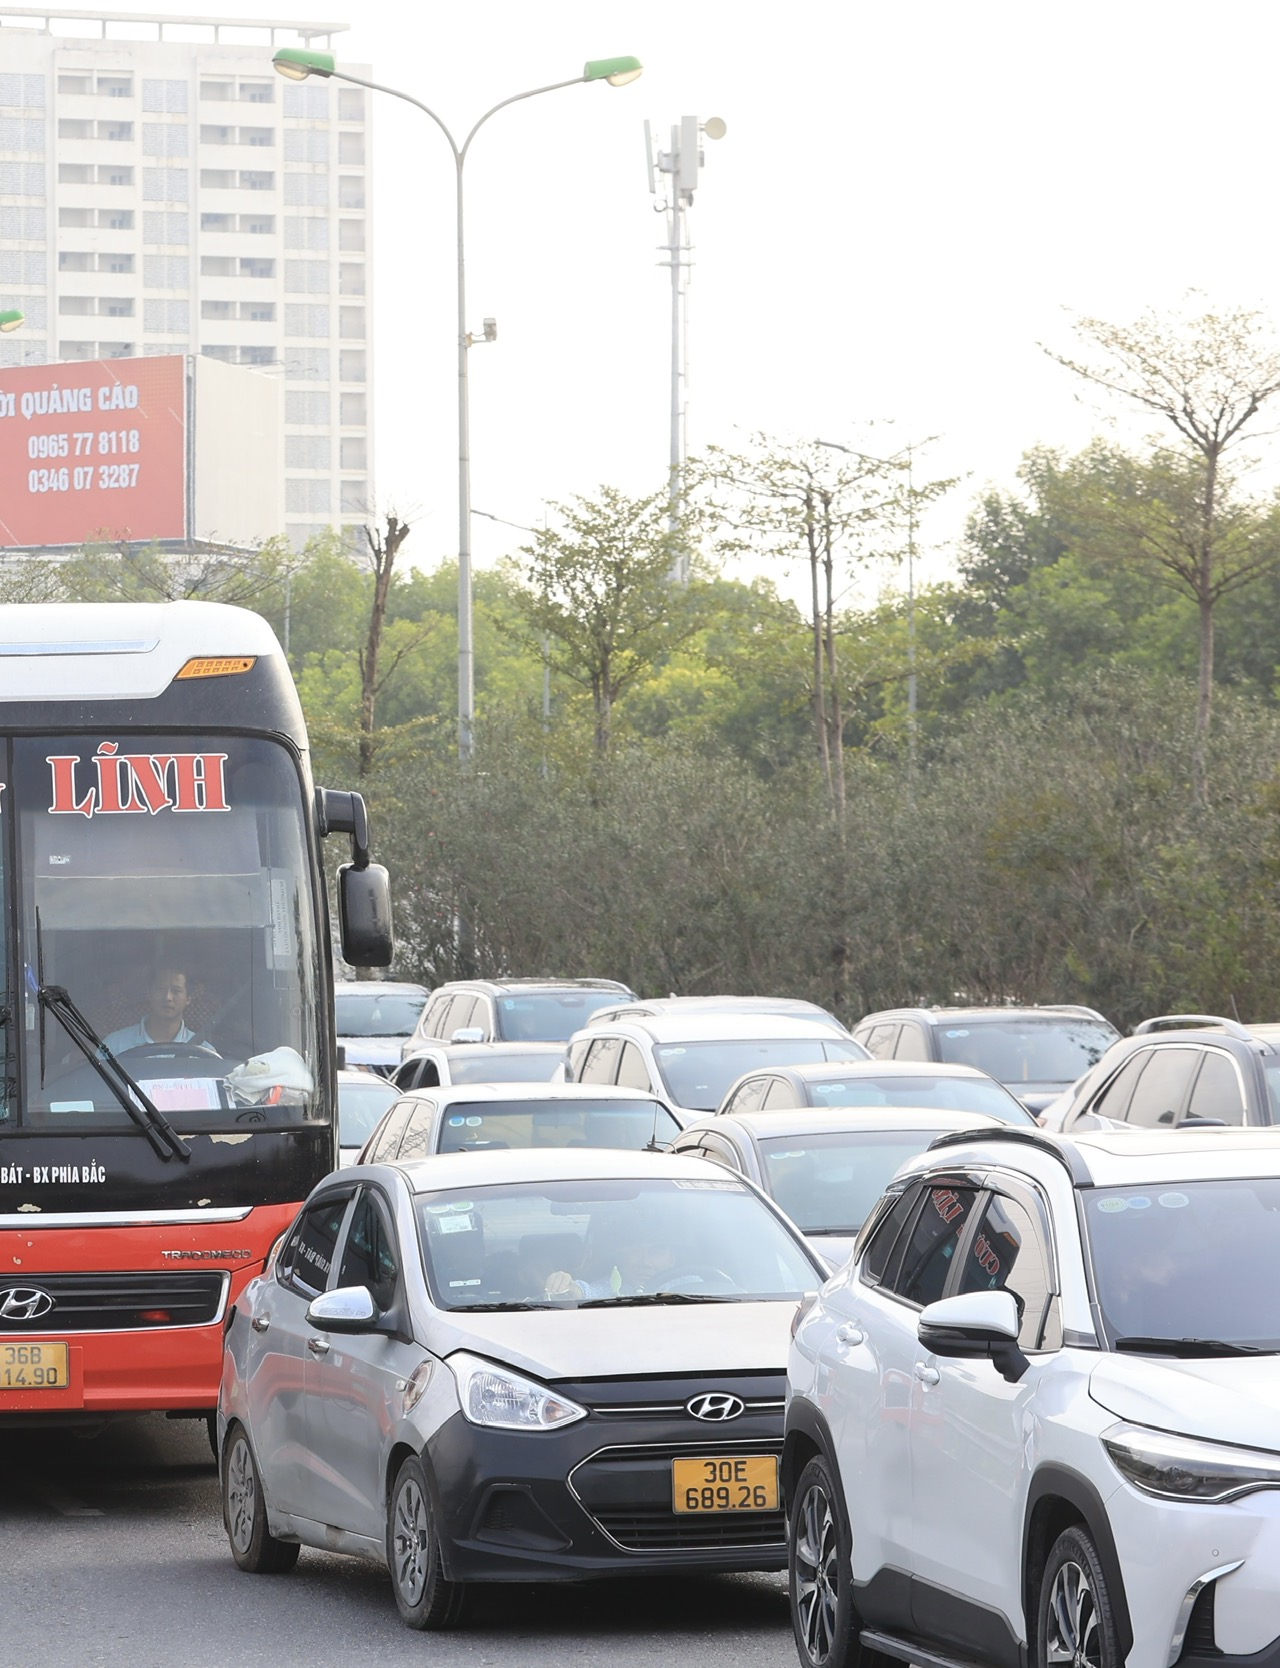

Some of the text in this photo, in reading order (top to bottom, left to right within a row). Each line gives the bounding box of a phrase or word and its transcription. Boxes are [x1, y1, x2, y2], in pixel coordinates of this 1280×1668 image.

[21, 384, 92, 420] QUẢNG
[98, 381, 139, 410] CÁO
[28, 430, 140, 459] 0965 77 8118
[28, 464, 140, 493] 0346 07 3287
[46, 741, 232, 819] LĨNH
[1, 1162, 23, 1184] BÁT
[33, 1166, 50, 1184] BX
[82, 1159, 106, 1184] BẮC
[4, 1346, 42, 1365] 36B
[703, 1460, 748, 1483] 30E
[685, 1485, 767, 1510] 689.26
